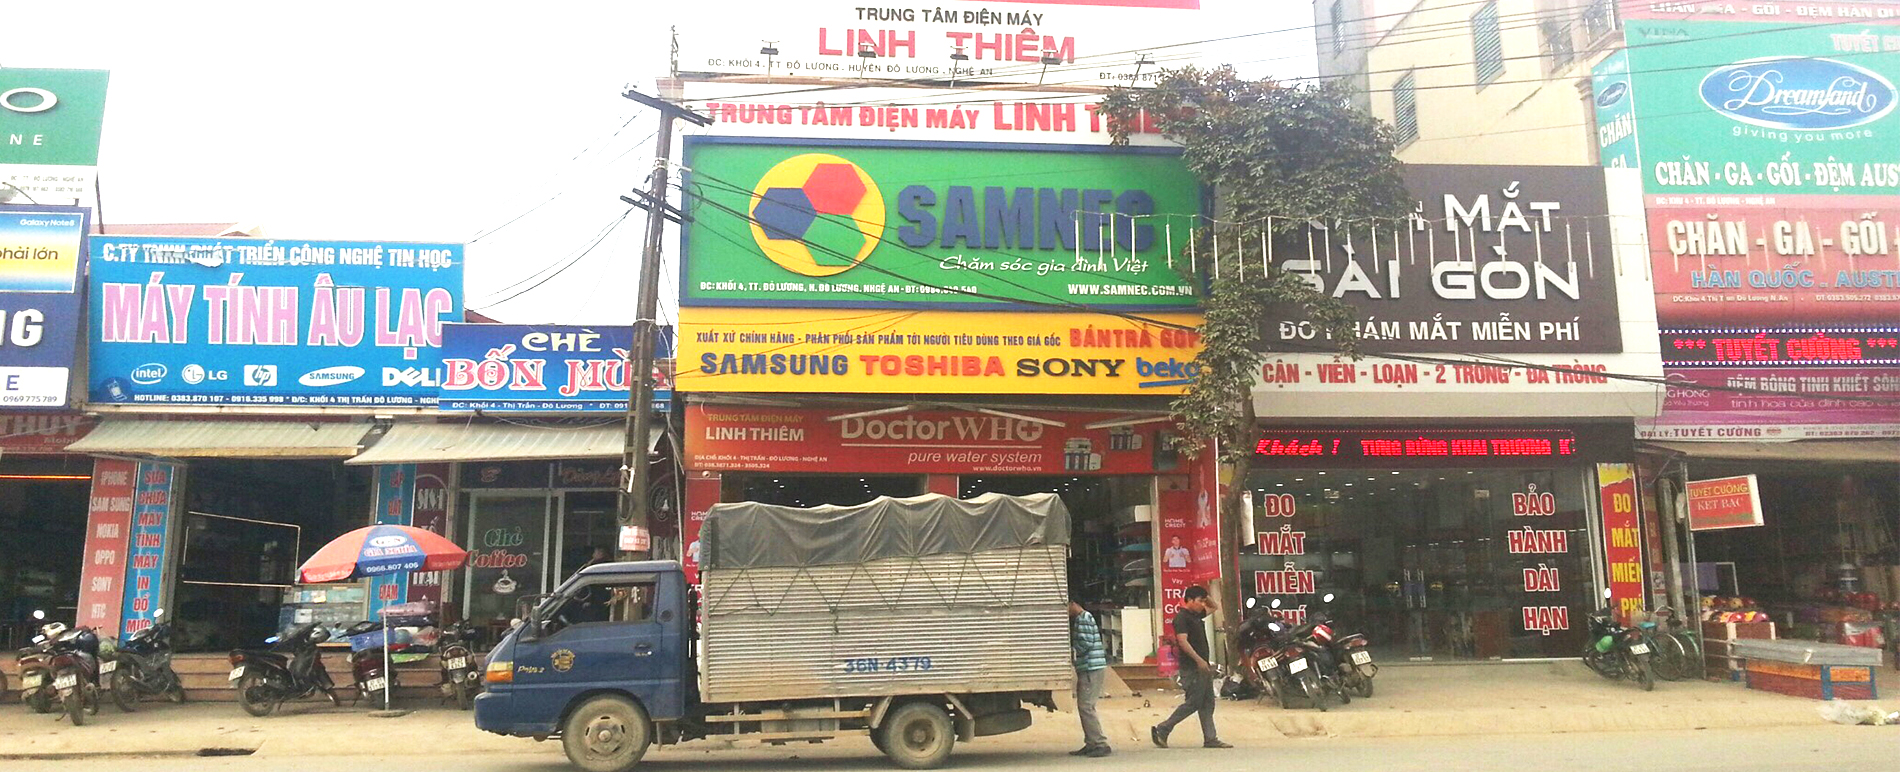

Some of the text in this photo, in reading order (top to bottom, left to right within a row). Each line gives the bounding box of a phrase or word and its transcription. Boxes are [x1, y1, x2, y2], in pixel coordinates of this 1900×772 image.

[855, 7, 1043, 26] TRUNG TÂM ĐIỆN MÁY
[1838, 5, 1873, 18] HÀN
[818, 27, 1075, 64] LINH THIÊM
[1724, 69, 1877, 115] Dreamland
[706, 103, 793, 125] TRUNG
[801, 101, 853, 126] TÂM
[859, 103, 918, 132] ĐIỆN
[926, 105, 979, 130] MÁY
[994, 102, 1076, 132] LINH
[1600, 112, 1632, 148] CHĂN
[1733, 125, 1873, 144] giving you more
[1655, 155, 1711, 187] CHĂN
[1724, 162, 1754, 187] GA
[1766, 151, 1803, 188] GỐI
[1814, 155, 1856, 192] ĐỆM
[897, 184, 1157, 251] SAMNEC
[1443, 181, 1561, 233] MẮT
[20, 218, 49, 227] Galaxy
[1666, 211, 1889, 256] CHĂN GA GỐI
[33, 246, 59, 261] lớn
[103, 239, 452, 272] C.TY TRIỂN CÔNG NGHỆ TIN HỌC
[940, 253, 1149, 276] Chăm sóc gia đình Việt
[1430, 246, 1580, 301] GÒN
[1691, 261, 1815, 289] HÀN QUỐC
[1068, 284, 1193, 296] WWW.SAMNEC.COM.VN
[102, 271, 453, 360] MÁY TÍNH ÂU LẠC
[1409, 311, 1462, 341] MẮT
[1472, 311, 1531, 341] MIỄN
[1539, 315, 1580, 341] PHÍ
[521, 328, 602, 352] CHÈ
[696, 328, 719, 344] XUẤT
[739, 331, 767, 344] CHÍNH
[769, 332, 795, 344] HÀNG
[856, 332, 875, 345] SẢN
[878, 330, 904, 345] PHẨM
[907, 333, 921, 345] TỚI
[923, 333, 951, 346] NGƯỜI
[954, 334, 973, 346] TIÊU
[976, 334, 999, 346] DÙNG
[1003, 335, 1024, 346] THEO
[1027, 332, 1041, 346] GIÁ
[1044, 332, 1061, 346] GỐC
[1711, 331, 1862, 361] TUYẾT CƯỜNG
[135, 368, 162, 379] intel
[208, 371, 228, 381] LG
[252, 365, 271, 386] hp
[309, 372, 355, 380] SAMSUNG
[442, 344, 547, 390] BỐN
[700, 353, 1200, 378] SAMSUNG TOSHIBA SONY beko
[1262, 362, 1300, 389] CẬN
[1317, 358, 1357, 384] VIỄN
[1372, 363, 1419, 389] LOẠN
[1435, 365, 1447, 384] 2
[1760, 373, 1871, 392] BÔNG TINH KHIẾT
[134, 395, 170, 403] HOTLINE:
[1763, 398, 1787, 408] hoa
[707, 413, 738, 422] TRUNG
[740, 414, 759, 422] TÂM
[784, 414, 804, 423] MÁY
[705, 425, 804, 441] LINH THIÊM
[1673, 423, 1761, 438] TUYẾT CƯỜNG
[908, 451, 1042, 465] pure water system
[1255, 438, 1488, 457] Khách KHAI
[100, 471, 128, 486] IPHONE
[92, 497, 131, 513] SAM SUNG
[1264, 493, 1296, 517] ĐO
[1512, 484, 1556, 516] BẢO
[1613, 493, 1632, 513] ĐO
[96, 523, 119, 539] NOKIA
[484, 526, 523, 547] Chè
[1258, 524, 1306, 555] MẮT
[1508, 521, 1568, 554] HÀNH
[1611, 520, 1639, 548] MẮT
[95, 549, 115, 565] OPPO
[133, 552, 159, 569] MÁY
[466, 549, 528, 568] Coffee
[92, 575, 113, 592] SONY
[136, 575, 150, 590] IN
[1255, 561, 1315, 595] MIỄN
[1524, 565, 1560, 593] DÀI
[91, 602, 106, 619] HTC
[1522, 606, 1569, 636] HẠN
